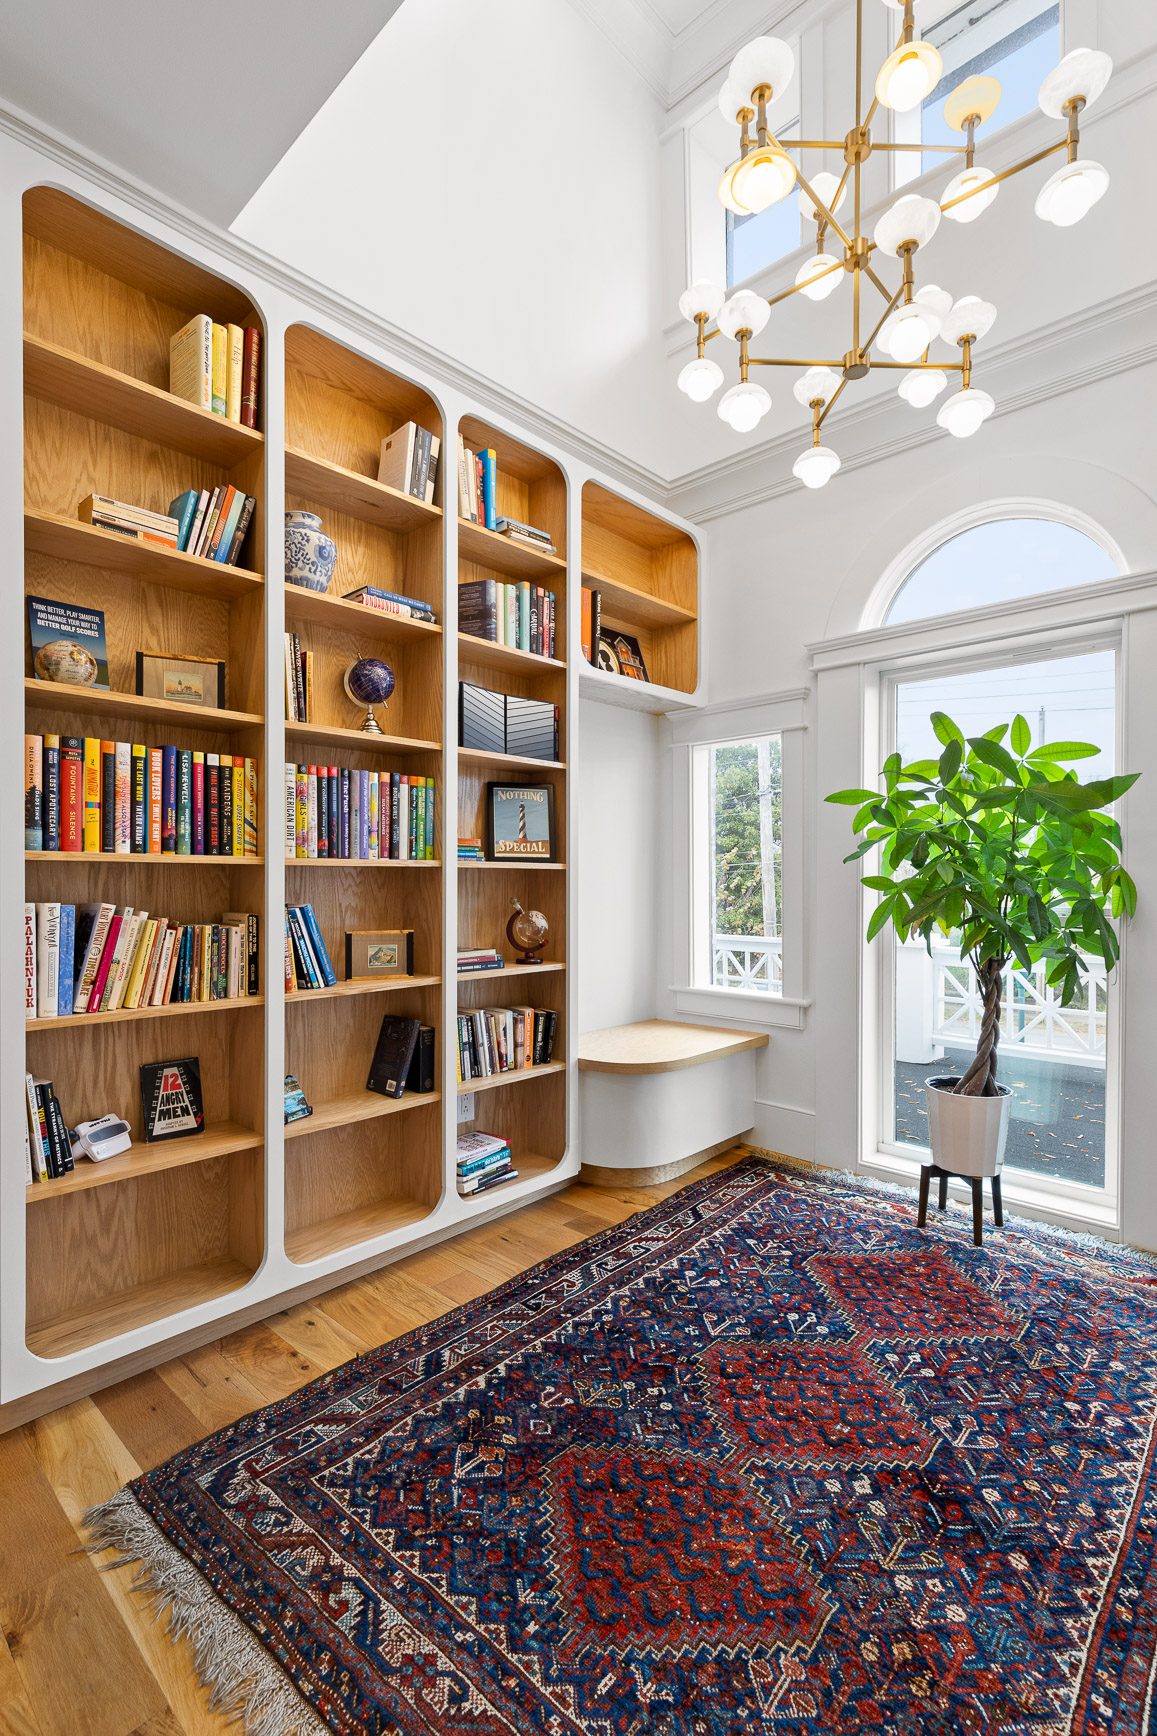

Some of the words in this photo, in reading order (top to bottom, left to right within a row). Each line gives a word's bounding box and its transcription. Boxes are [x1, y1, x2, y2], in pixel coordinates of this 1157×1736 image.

[232, 346, 241, 365] Help
[32, 602, 46, 611] THINK
[47, 606, 66, 616] BETTER,
[67, 610, 78, 619] PLAY
[78, 612, 100, 623] SMARTER,
[366, 596, 399, 614] UNDAUNTED
[37, 619, 60, 629] BETTER
[61, 624, 76, 632] GOLF
[76, 628, 98, 637] SCORES
[48, 614, 67, 624] MANAGE
[152, 752, 160, 770] BOOK
[152, 773, 160, 801] LOVERS
[498, 791, 543, 802] NOTHING
[499, 839, 545, 852] SPECIAL
[100, 907, 112, 920] KURT
[92, 922, 110, 946] VONNEGUT
[25, 916, 34, 1008] PALAHNIUK
[80, 957, 97, 996] TIMEQUAKE
[118, 962, 126, 981] SLAPSTICK
[162, 1073, 182, 1092] 12
[159, 1091, 186, 1108] ANGRY
[158, 1104, 191, 1122] MEN
[42, 1138, 50, 1156] THIS
